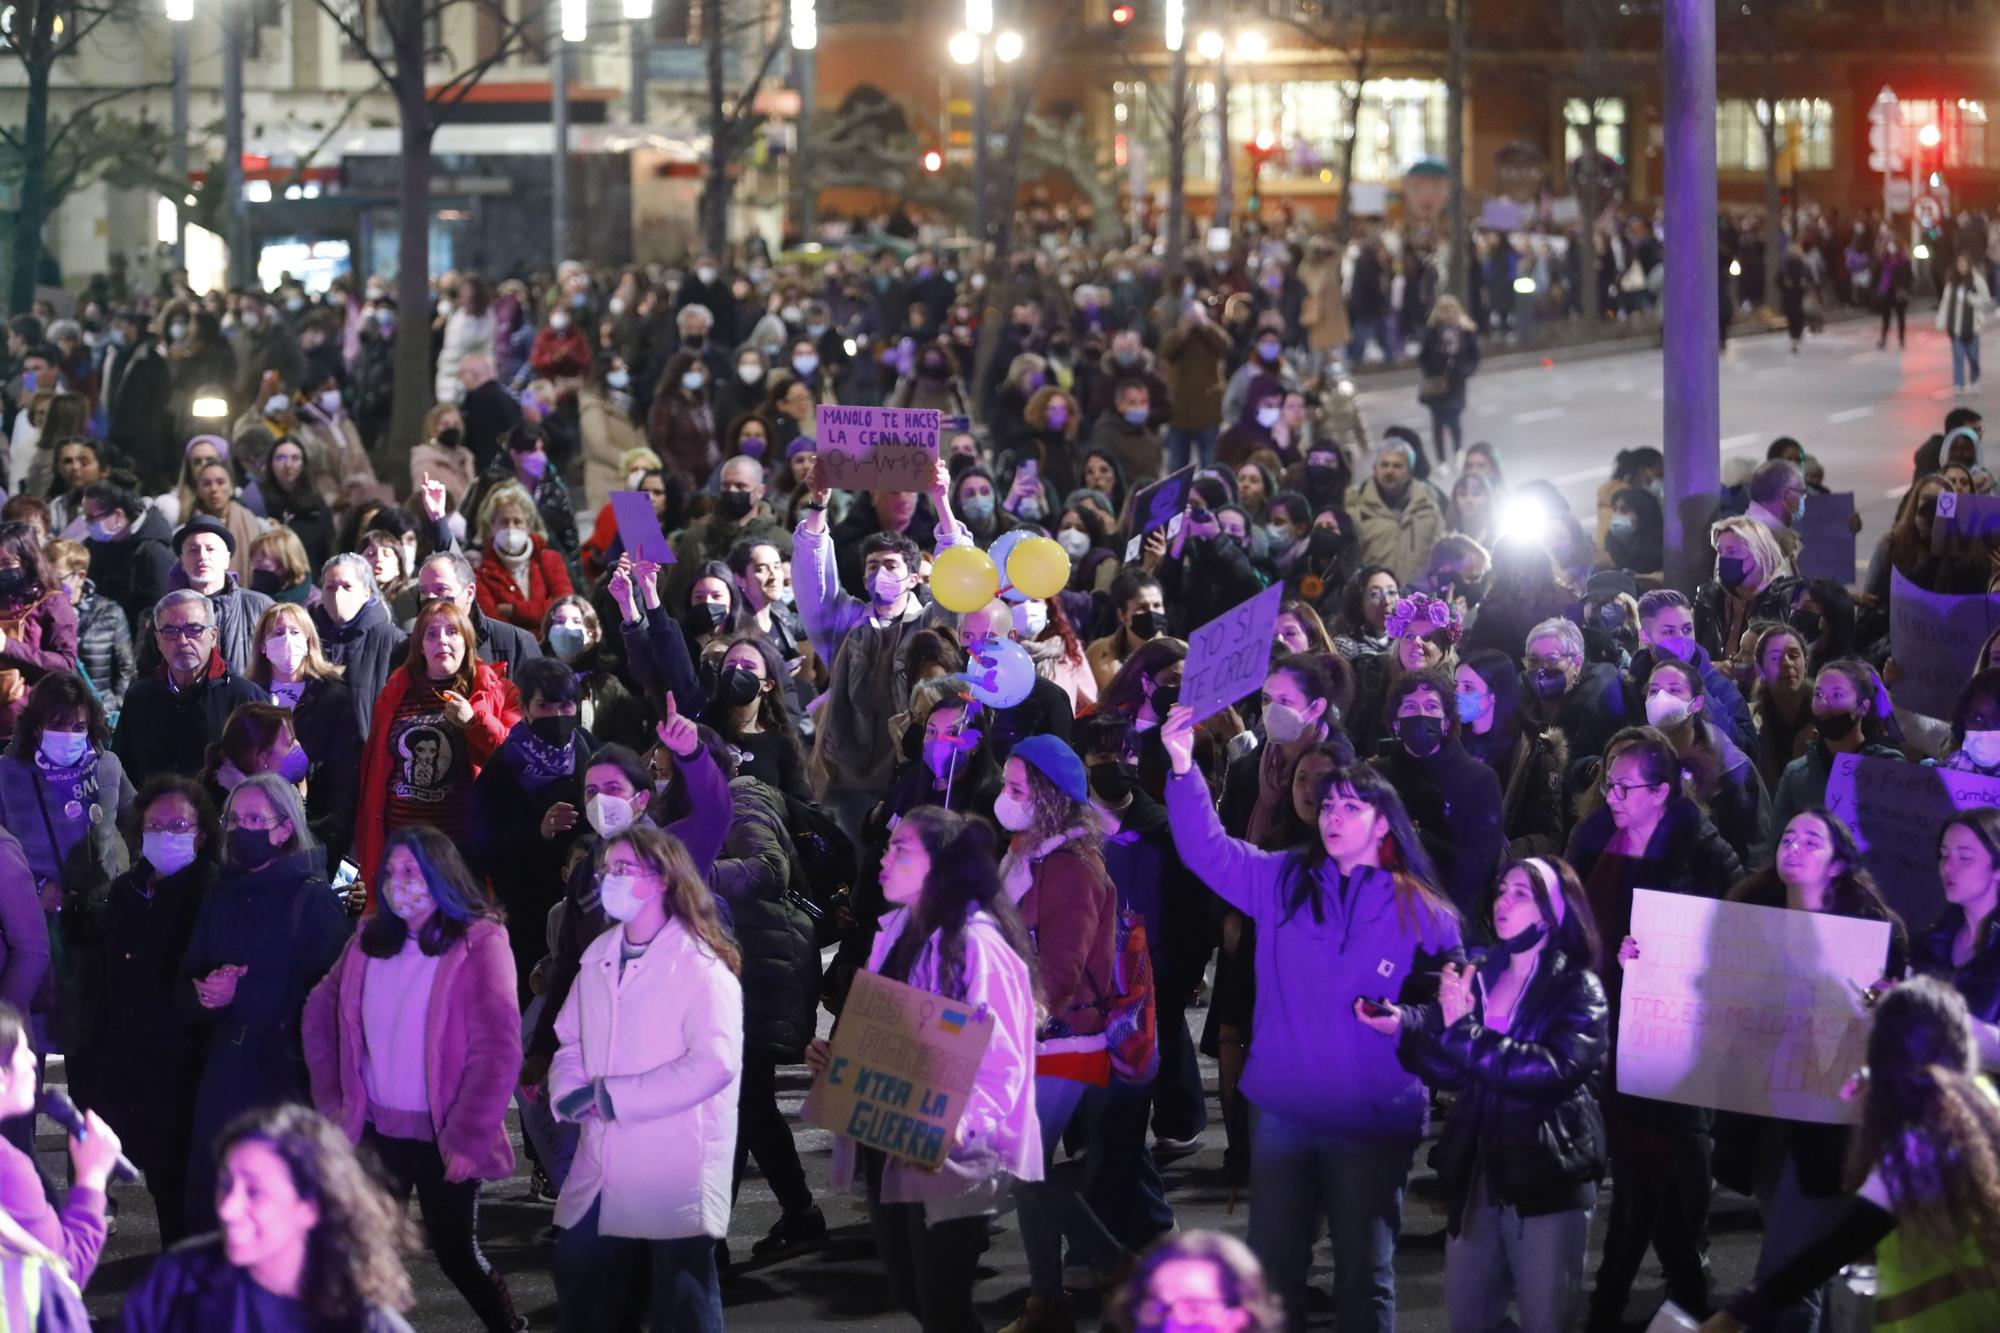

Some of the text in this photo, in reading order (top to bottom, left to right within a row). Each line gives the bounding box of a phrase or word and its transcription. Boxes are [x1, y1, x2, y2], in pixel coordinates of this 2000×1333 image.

[823, 410, 939, 431] MANOLO TE HACES
[828, 430, 936, 448] LA CENA SOLO
[1200, 622, 1225, 661] YO
[1186, 638, 1264, 704] TE CREO
[72, 775, 99, 799] 8M
[852, 979, 909, 1025] LAS
[919, 1088, 949, 1119] LA
[846, 1100, 946, 1162] GUERRA
